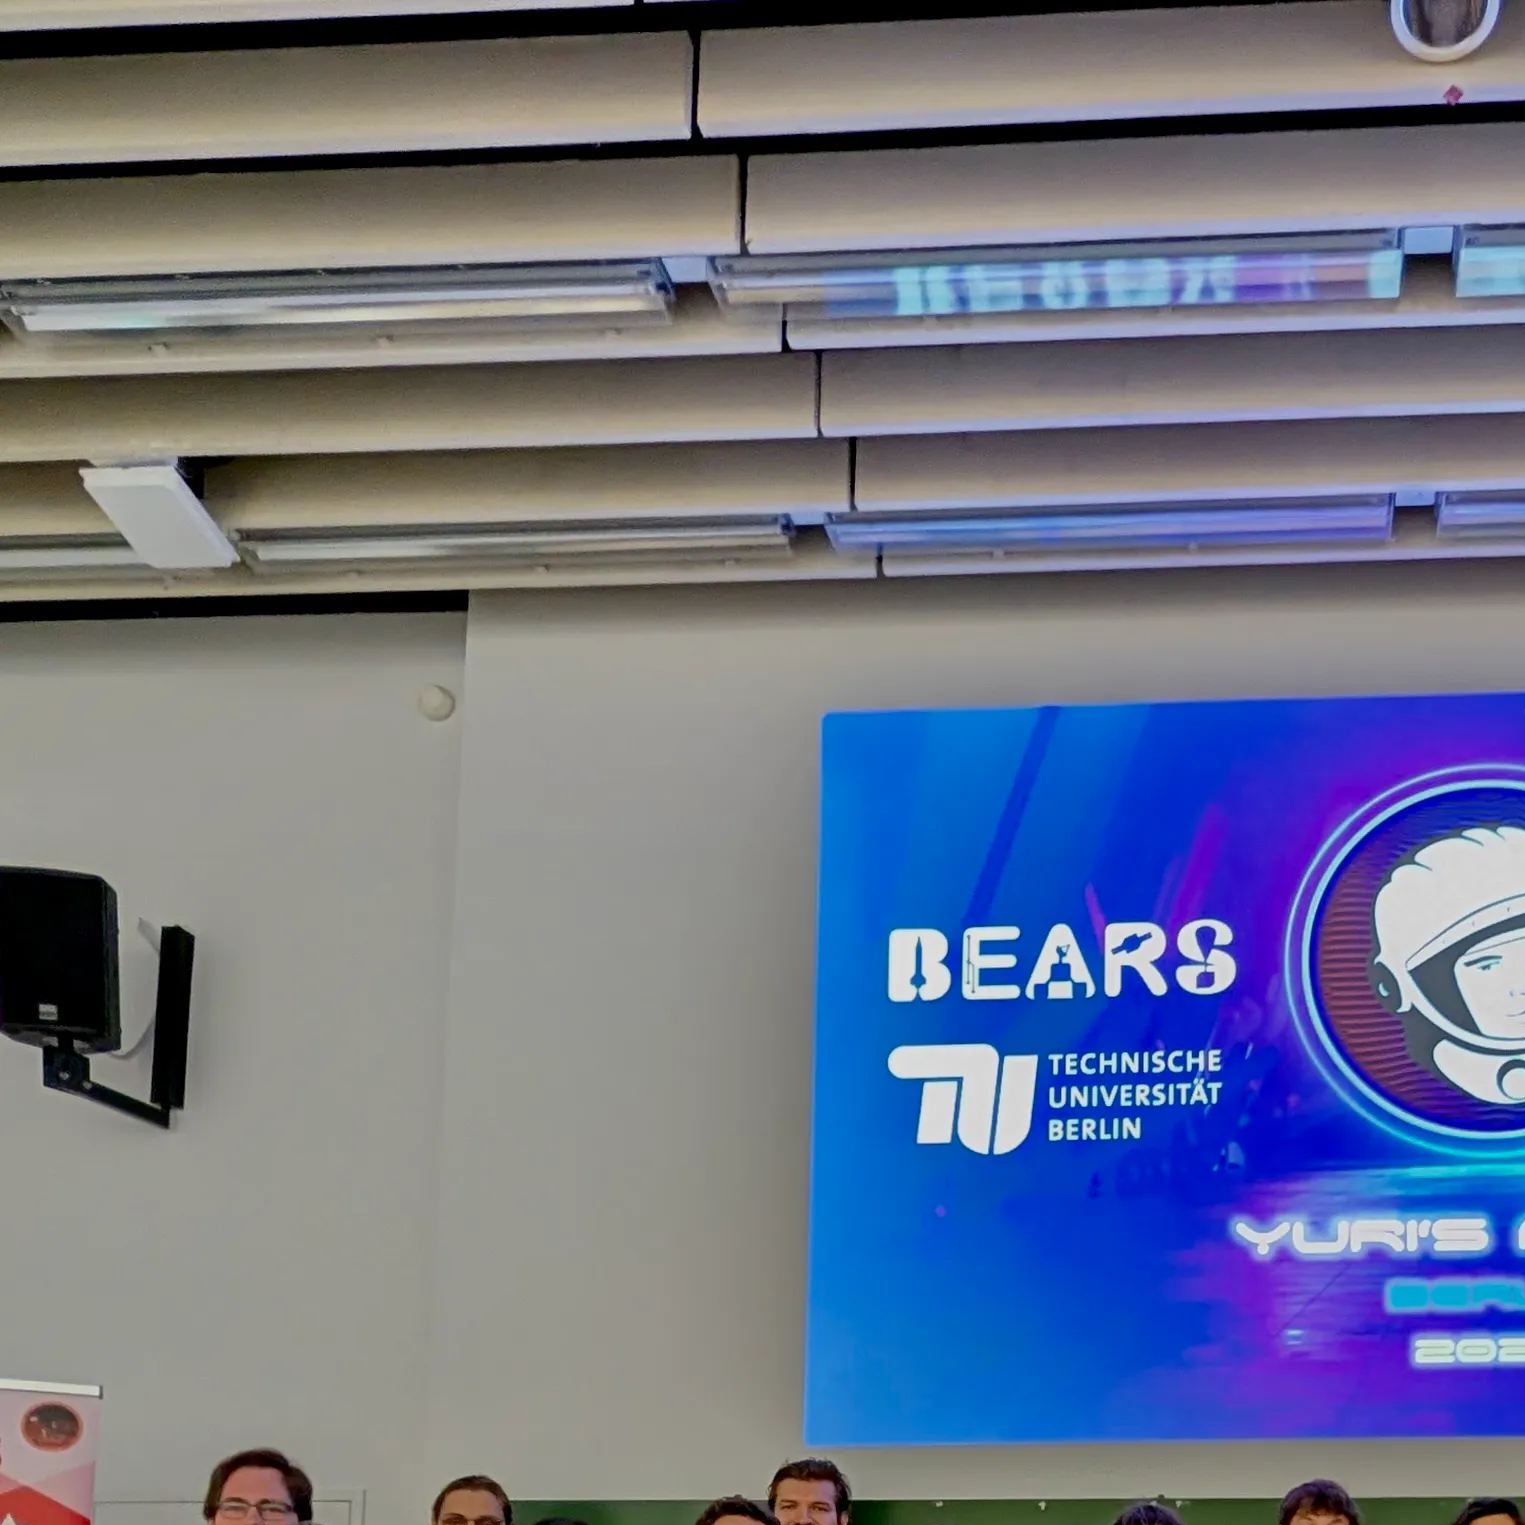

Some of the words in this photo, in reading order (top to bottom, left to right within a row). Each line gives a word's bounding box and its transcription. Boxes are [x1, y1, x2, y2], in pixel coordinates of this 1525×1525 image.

[888, 918, 1237, 1002] BEARS
[1048, 1048, 1223, 1076] TECHNISCHE
[1048, 1077, 1223, 1109] UNIVERSITÄT
[1048, 1116, 1142, 1142] BERLIN
[1235, 1217, 1490, 1256] YURI'S
